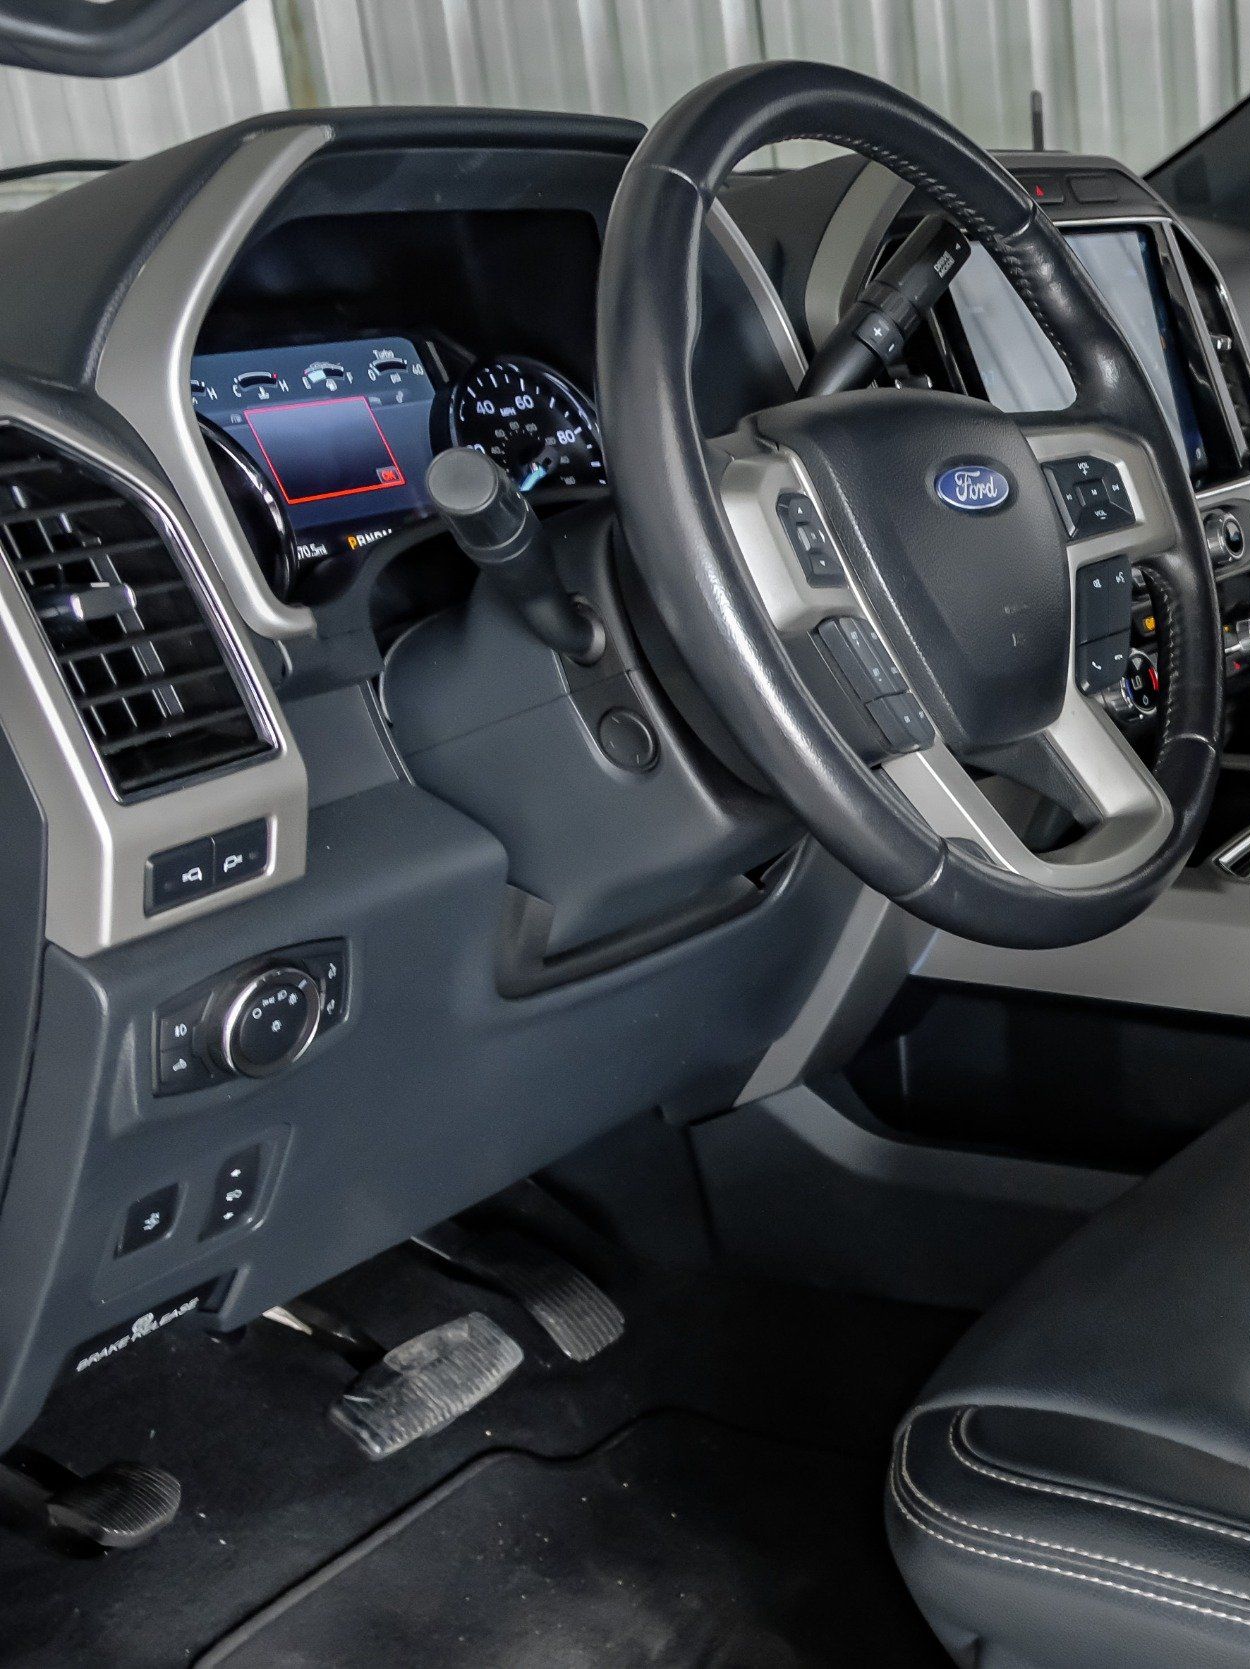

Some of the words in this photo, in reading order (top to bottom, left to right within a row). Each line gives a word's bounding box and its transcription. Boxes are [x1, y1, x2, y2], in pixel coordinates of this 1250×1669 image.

[476, 399, 495, 415] 40
[514, 394, 534, 411] 60
[556, 429, 576, 445] 80
[381, 470, 397, 481] OK
[954, 470, 998, 502] Ford
[76, 1334, 131, 1372] BRAKE
